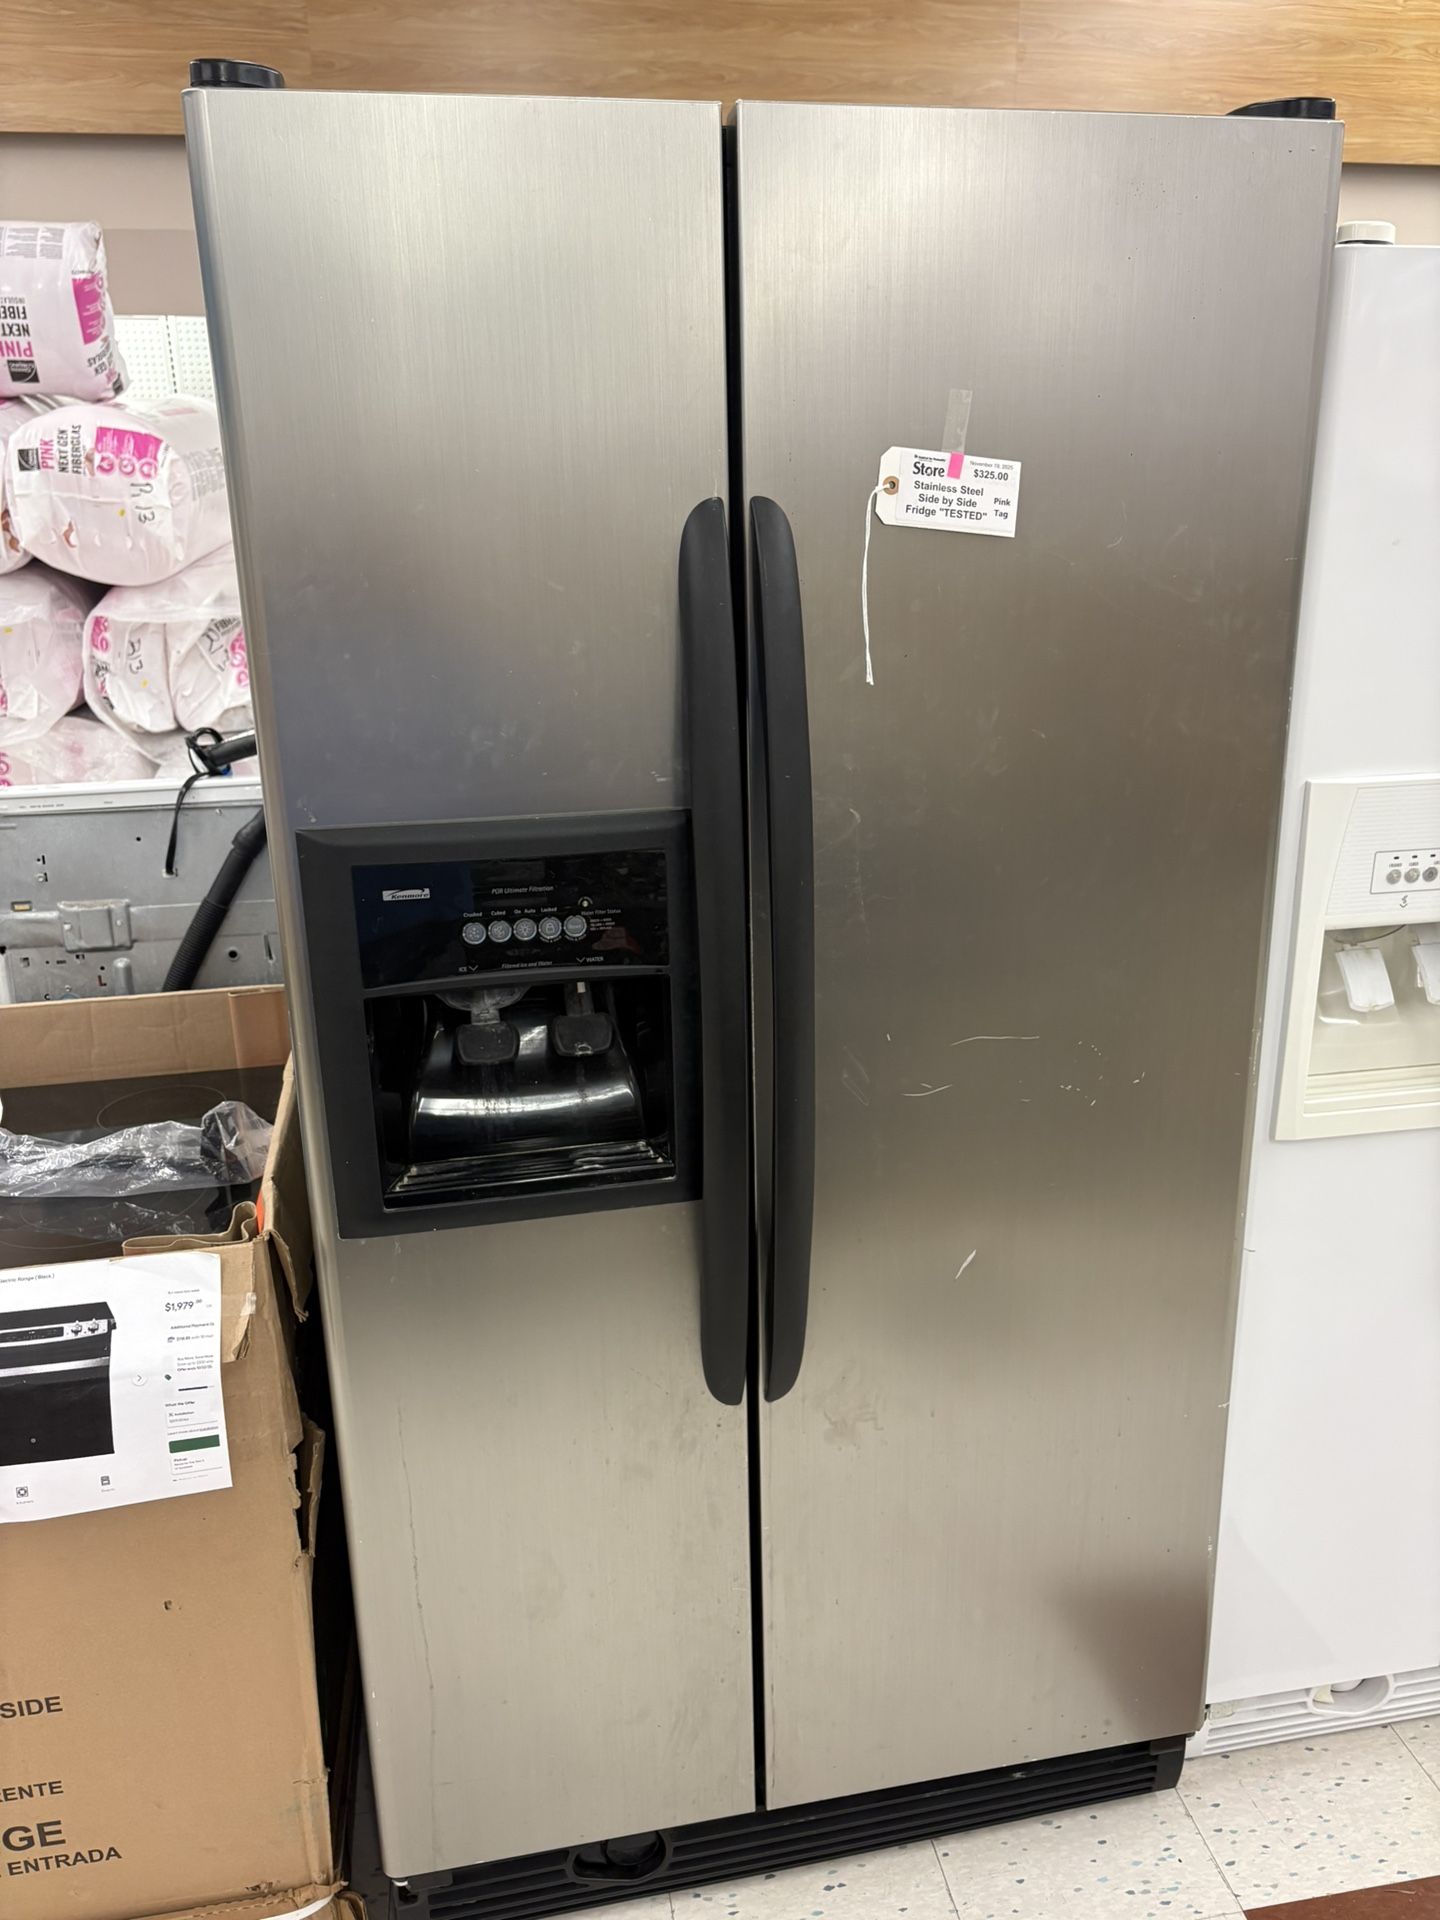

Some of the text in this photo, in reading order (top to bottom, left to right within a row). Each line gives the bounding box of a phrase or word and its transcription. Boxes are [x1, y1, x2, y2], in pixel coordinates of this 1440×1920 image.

[0, 305, 27, 320] FIBE
[1, 323, 31, 337] NEXT
[0, 341, 34, 357] PIN
[40, 438, 54, 470] PINK
[57, 429, 69, 473] NEXT GEN
[71, 424, 82, 475] FIBERGLAS
[912, 461, 945, 478] Store
[973, 469, 1009, 481] $325.00
[914, 480, 984, 496] Stainless Steel
[918, 493, 977, 508] Side by Side
[993, 497, 1011, 506] Pink
[905, 504, 987, 521] Fridge "TESTED"
[994, 510, 1008, 519] Tag
[164, 1301, 194, 1312] $1,979
[0, 1695, 63, 1719] SIDE
[0, 1780, 64, 1803] ENTE
[2, 1820, 66, 1851] GE
[7, 1846, 122, 1876] ENTRADA
